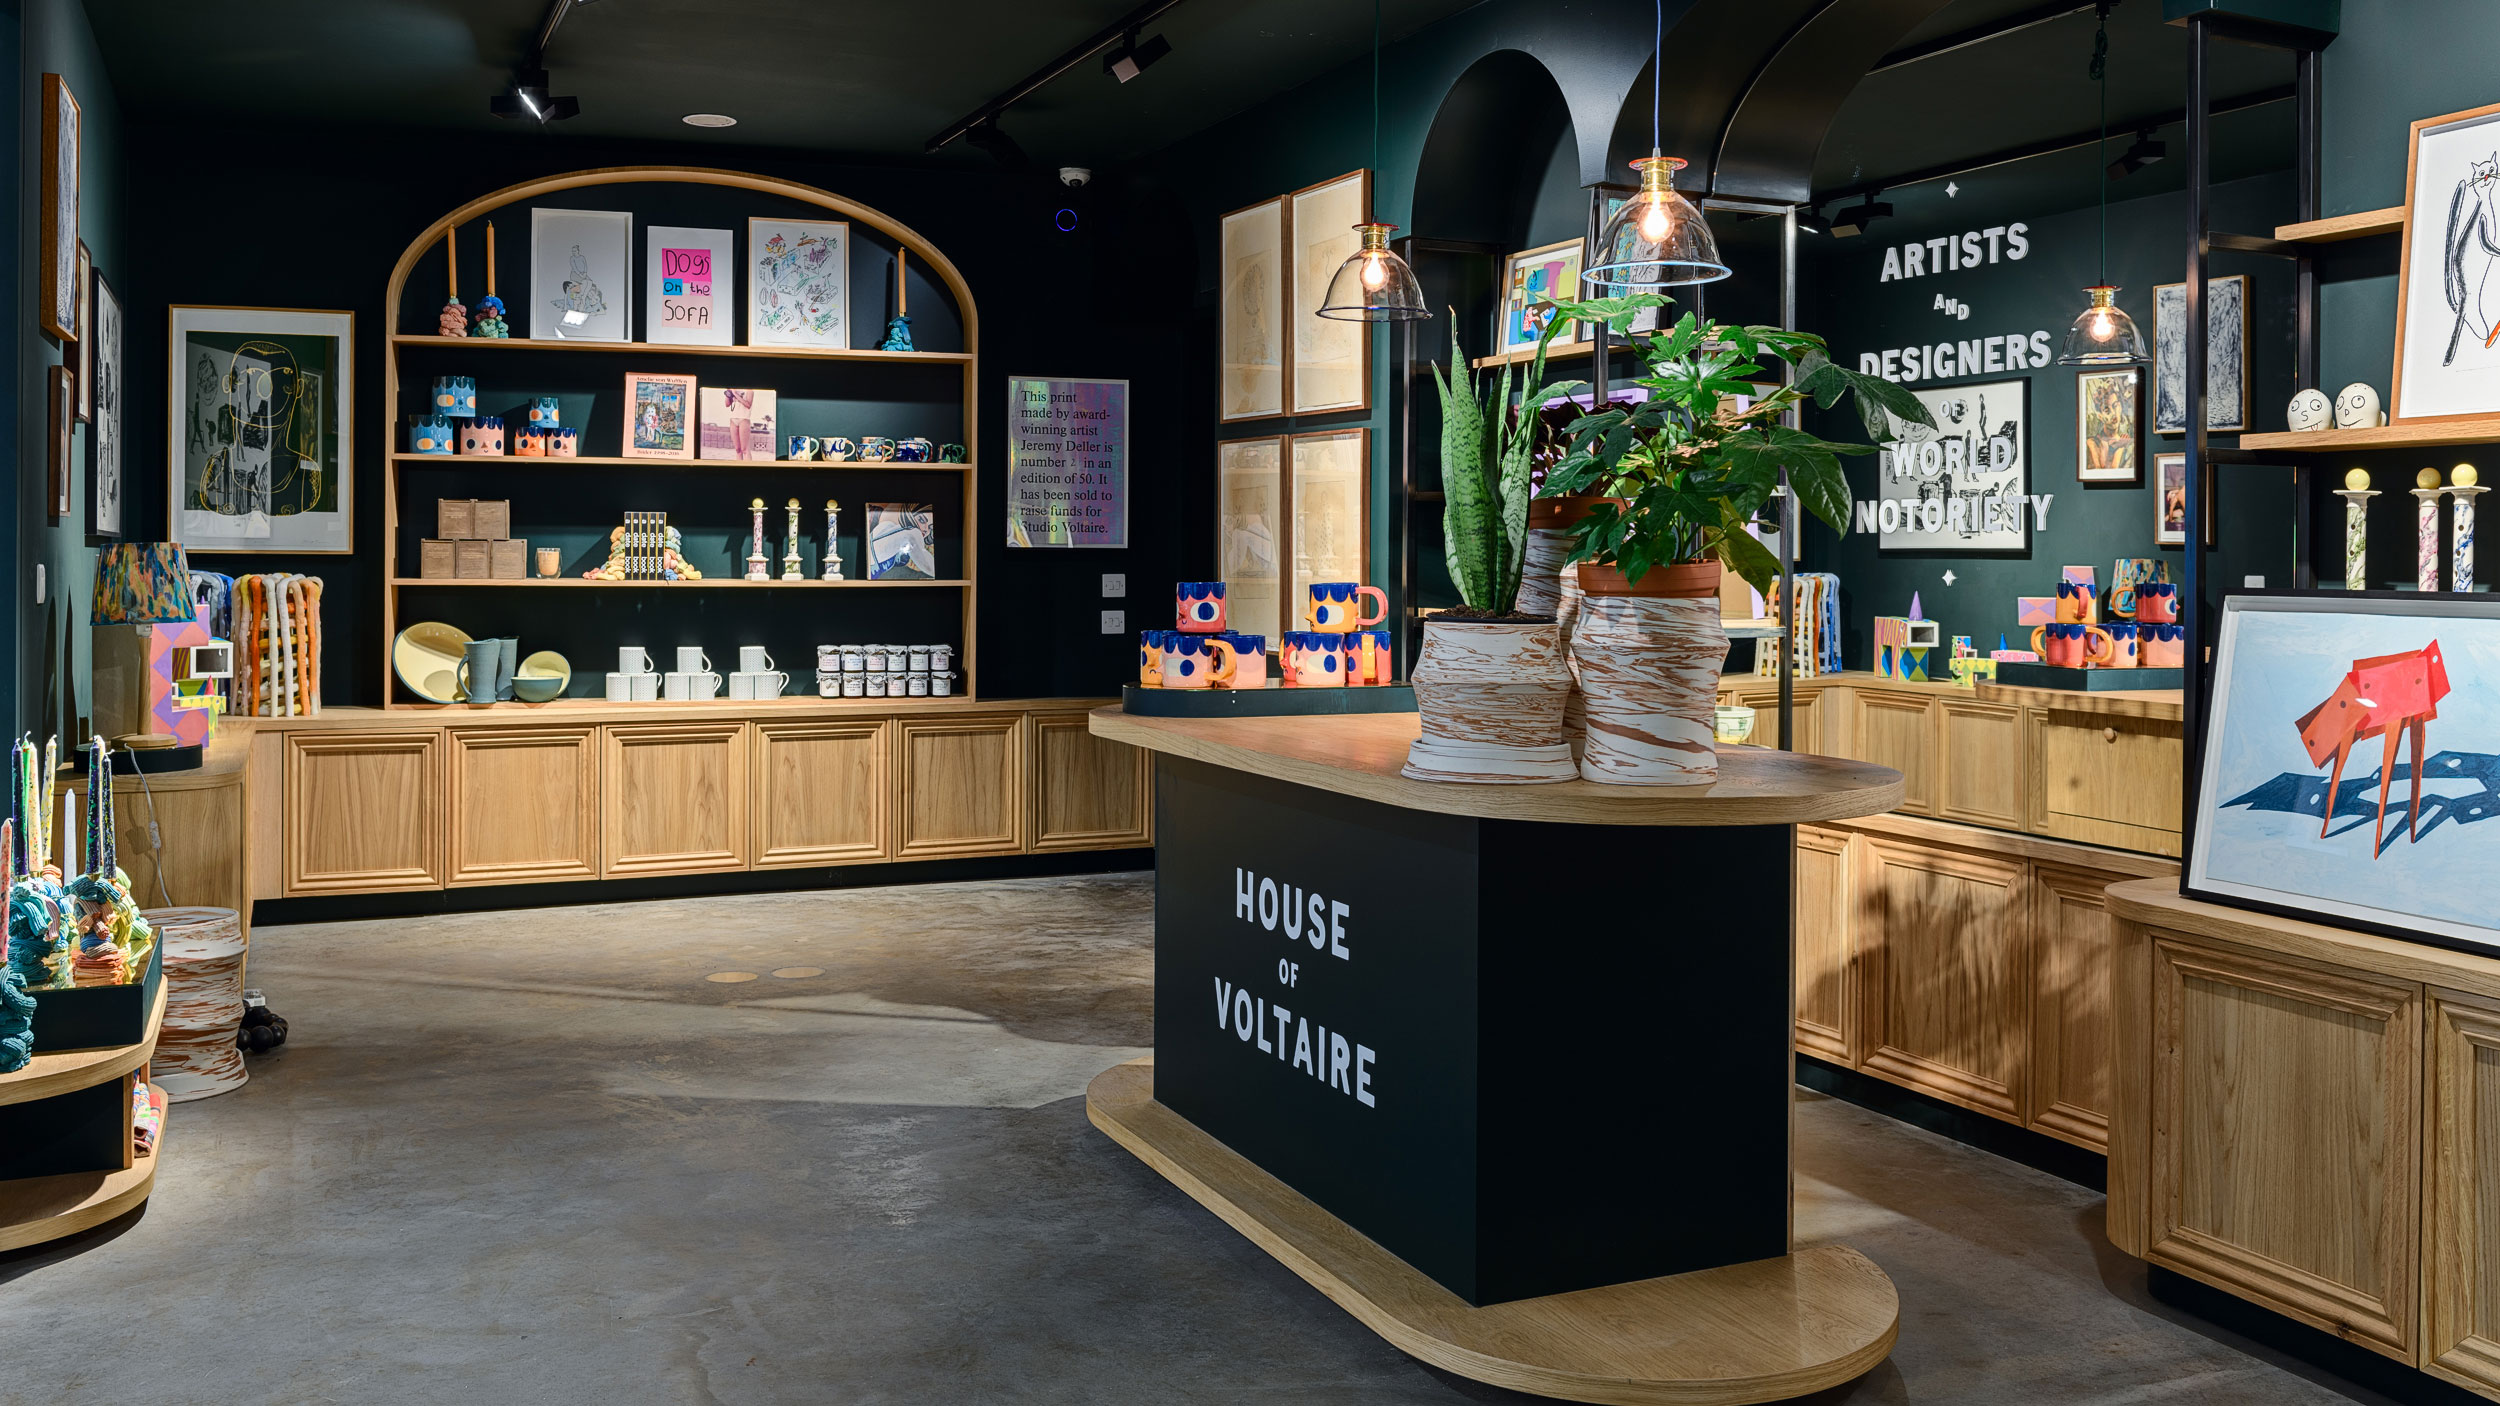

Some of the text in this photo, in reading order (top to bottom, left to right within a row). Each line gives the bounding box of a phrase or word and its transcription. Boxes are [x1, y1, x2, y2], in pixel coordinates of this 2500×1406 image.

[1880, 222, 2029, 282] ARTISTS
[690, 282, 710, 296] the
[664, 299, 708, 325] SOFA
[1933, 293, 1970, 320] AND
[1860, 330, 2052, 383] DESIGNERS
[1021, 391, 1077, 404] This print
[1021, 408, 1110, 421] made by award-
[1939, 401, 1961, 417] OF
[1021, 423, 1098, 437] winning artist
[1021, 440, 1113, 453] Jeremy Deller is
[1021, 457, 1066, 467] number
[1084, 457, 1095, 468] in
[1098, 460, 1112, 469] an
[1890, 436, 2013, 477] WORLD
[1020, 473, 1107, 485] edition of 50. It
[1020, 489, 1112, 501] has been sold to
[1020, 505, 1102, 517] raise funds for
[1856, 494, 2054, 534] NOTORIETY
[1021, 521, 1108, 534] Studio Voltaire.
[1236, 867, 1350, 961] HOUSE
[1278, 958, 1299, 988] OF
[1214, 976, 1376, 1109] VOLTAIRE
